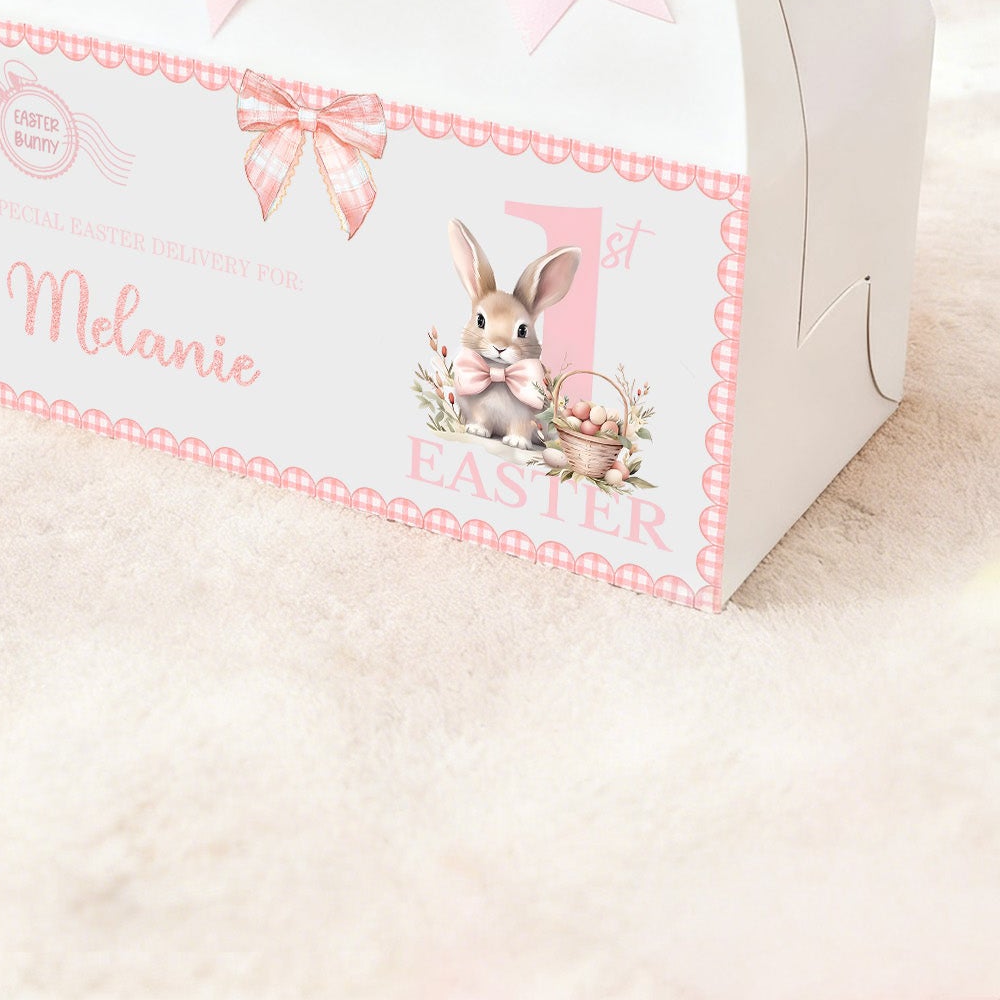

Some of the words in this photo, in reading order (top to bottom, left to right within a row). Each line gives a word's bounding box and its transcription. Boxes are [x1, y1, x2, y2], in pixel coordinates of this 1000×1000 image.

[14, 109, 60, 133] EASTER
[69, 216, 147, 252] EASTER
[151, 236, 251, 279] DELIVERY
[255, 263, 304, 292] FOR:
[6, 260, 262, 388] Melanie
[405, 434, 673, 553] EASTER
